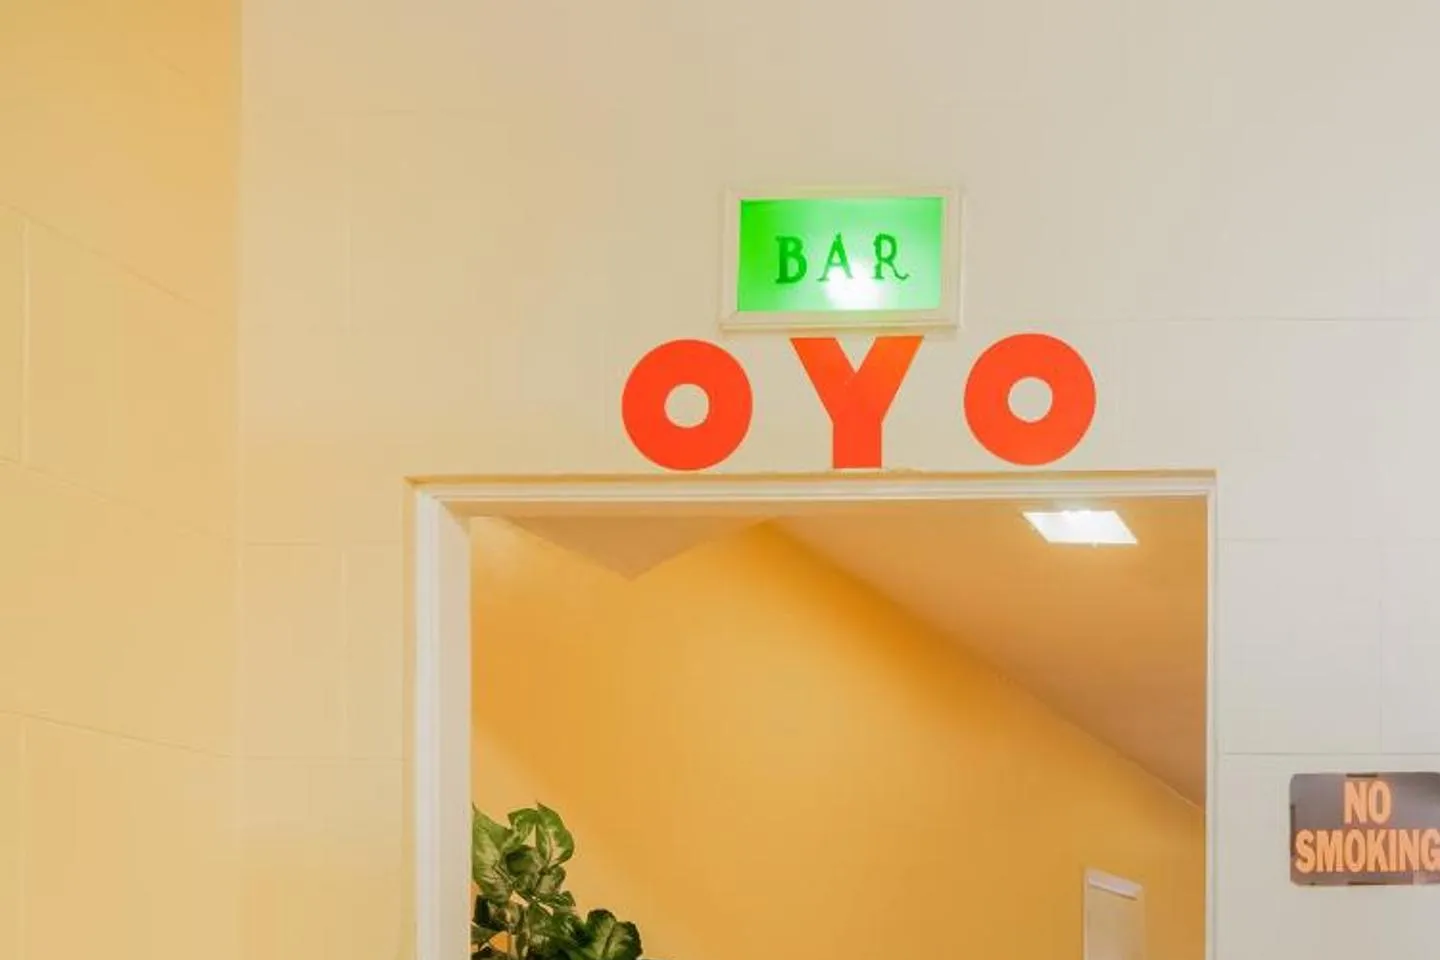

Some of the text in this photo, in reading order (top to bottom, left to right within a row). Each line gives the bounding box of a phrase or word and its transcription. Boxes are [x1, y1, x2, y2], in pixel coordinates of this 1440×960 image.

[774, 232, 910, 285] BAR
[621, 332, 1097, 472] OYO
[1343, 780, 1392, 825] NO
